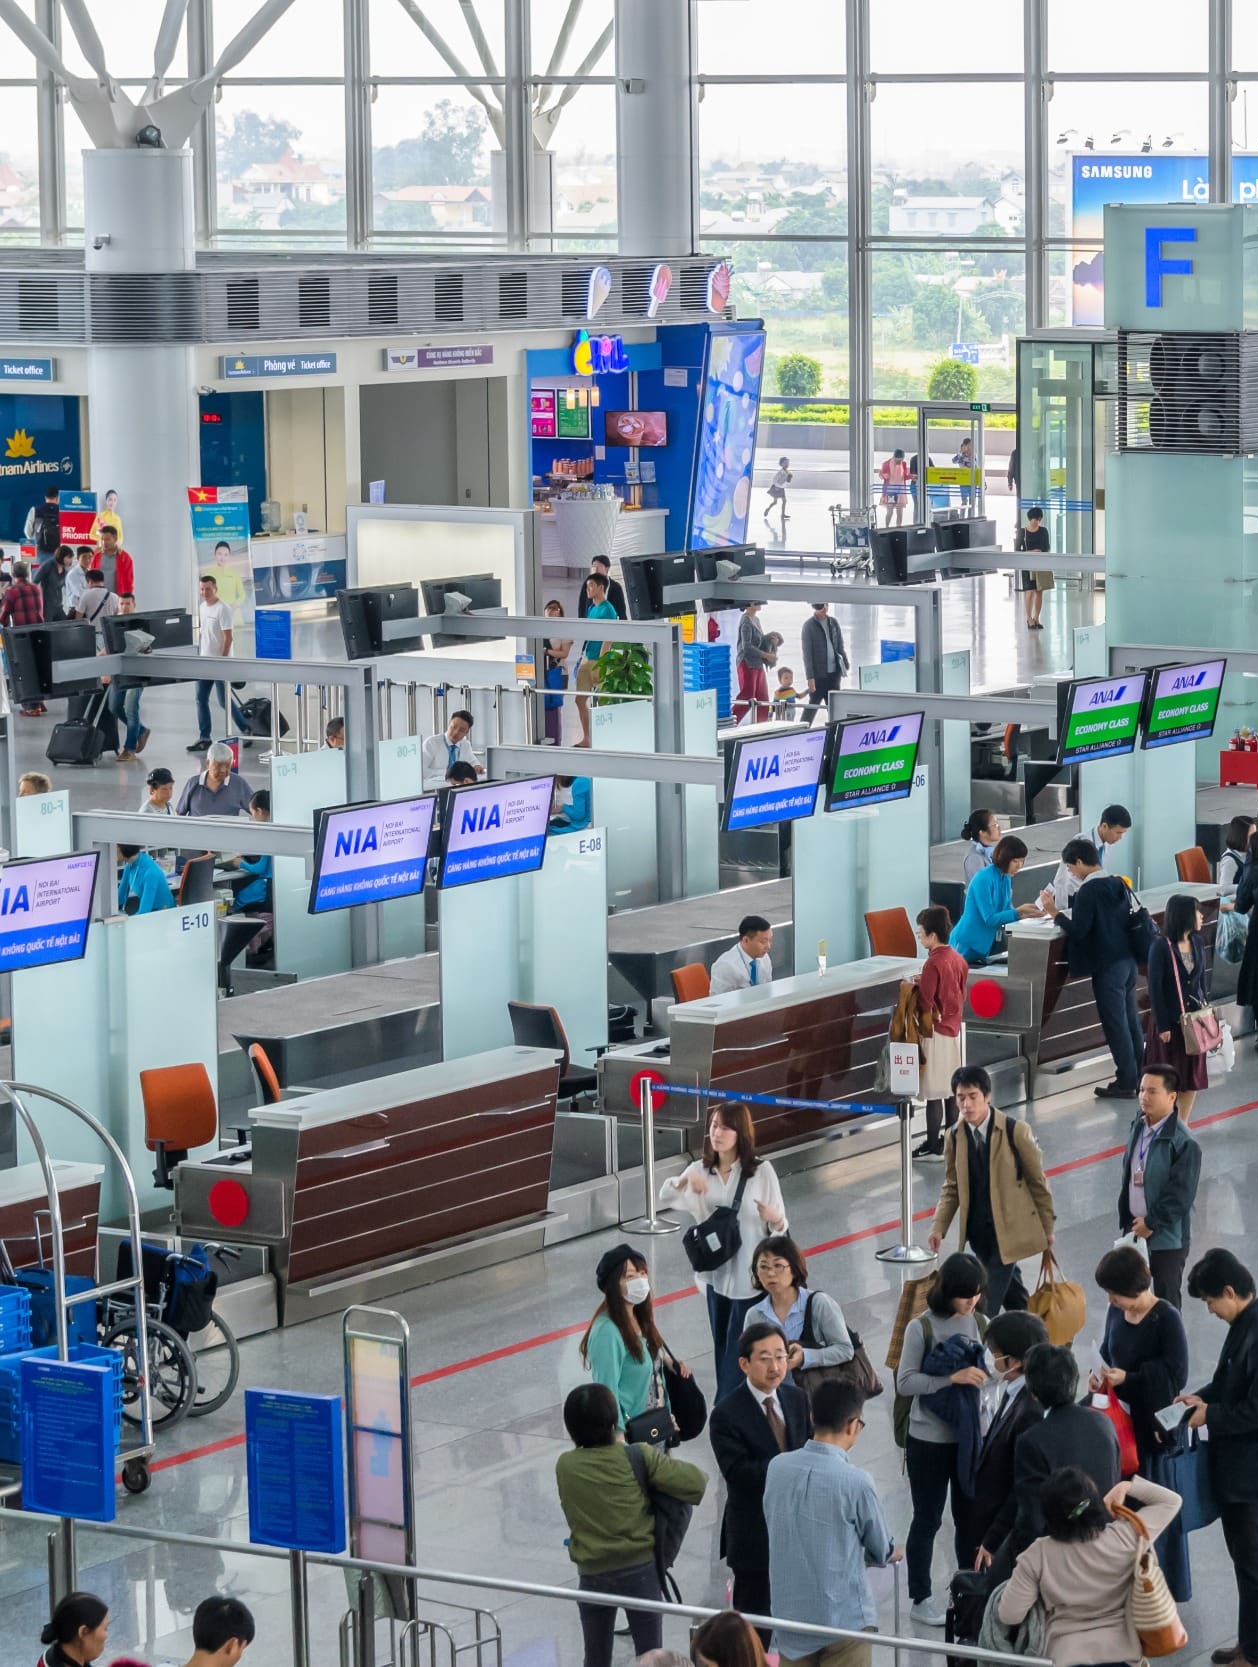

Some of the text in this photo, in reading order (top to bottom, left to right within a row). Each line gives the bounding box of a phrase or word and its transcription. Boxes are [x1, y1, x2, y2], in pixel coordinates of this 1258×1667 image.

[1081, 165, 1153, 179] SAMSUNG
[1145, 227, 1198, 308] F
[4, 365, 43, 375] Ticket office
[264, 359, 286, 372] Phòng
[287, 359, 296, 370] vé
[301, 359, 331, 369] Ticket office
[0, 460, 59, 476] tnamAirlines
[1172, 675, 1195, 691] ANA
[1089, 690, 1114, 706] ANA
[1158, 702, 1209, 720] ECONOMY CLASS
[1075, 717, 1129, 736] ECONOMY CLASS
[1158, 726, 1196, 738] STAR ALLIANCE
[859, 730, 887, 747] ANA
[1075, 741, 1116, 754] STAR ALLIANCE
[745, 755, 780, 782] NIA
[844, 760, 904, 779] ECONOMY CLASS
[912, 774, 925, 787] -06
[844, 785, 889, 799] STAR ALLIANCE
[506, 805, 541, 816] INTERNATIONAL
[460, 804, 501, 835] NIA
[505, 816, 525, 824] AIRPORT
[384, 826, 421, 838] INTERNATIONAL
[334, 826, 378, 858] NIA
[383, 837, 404, 847] AIRPORT
[579, 837, 601, 854] E-08
[497, 852, 512, 865] QUỐC
[374, 876, 389, 889] QUỐC
[391, 873, 398, 885] TẾ
[37, 885, 80, 898] INTERNATIONAL
[0, 885, 29, 916] IA
[36, 898, 60, 908] AIRPORT
[182, 912, 209, 931] E-10
[1, 943, 26, 956] KHÔNG
[26, 937, 46, 953] QUỐC
[46, 935, 54, 948] TẾ
[55, 936, 68, 948] NỘI
[894, 1055, 914, 1065] 出口
